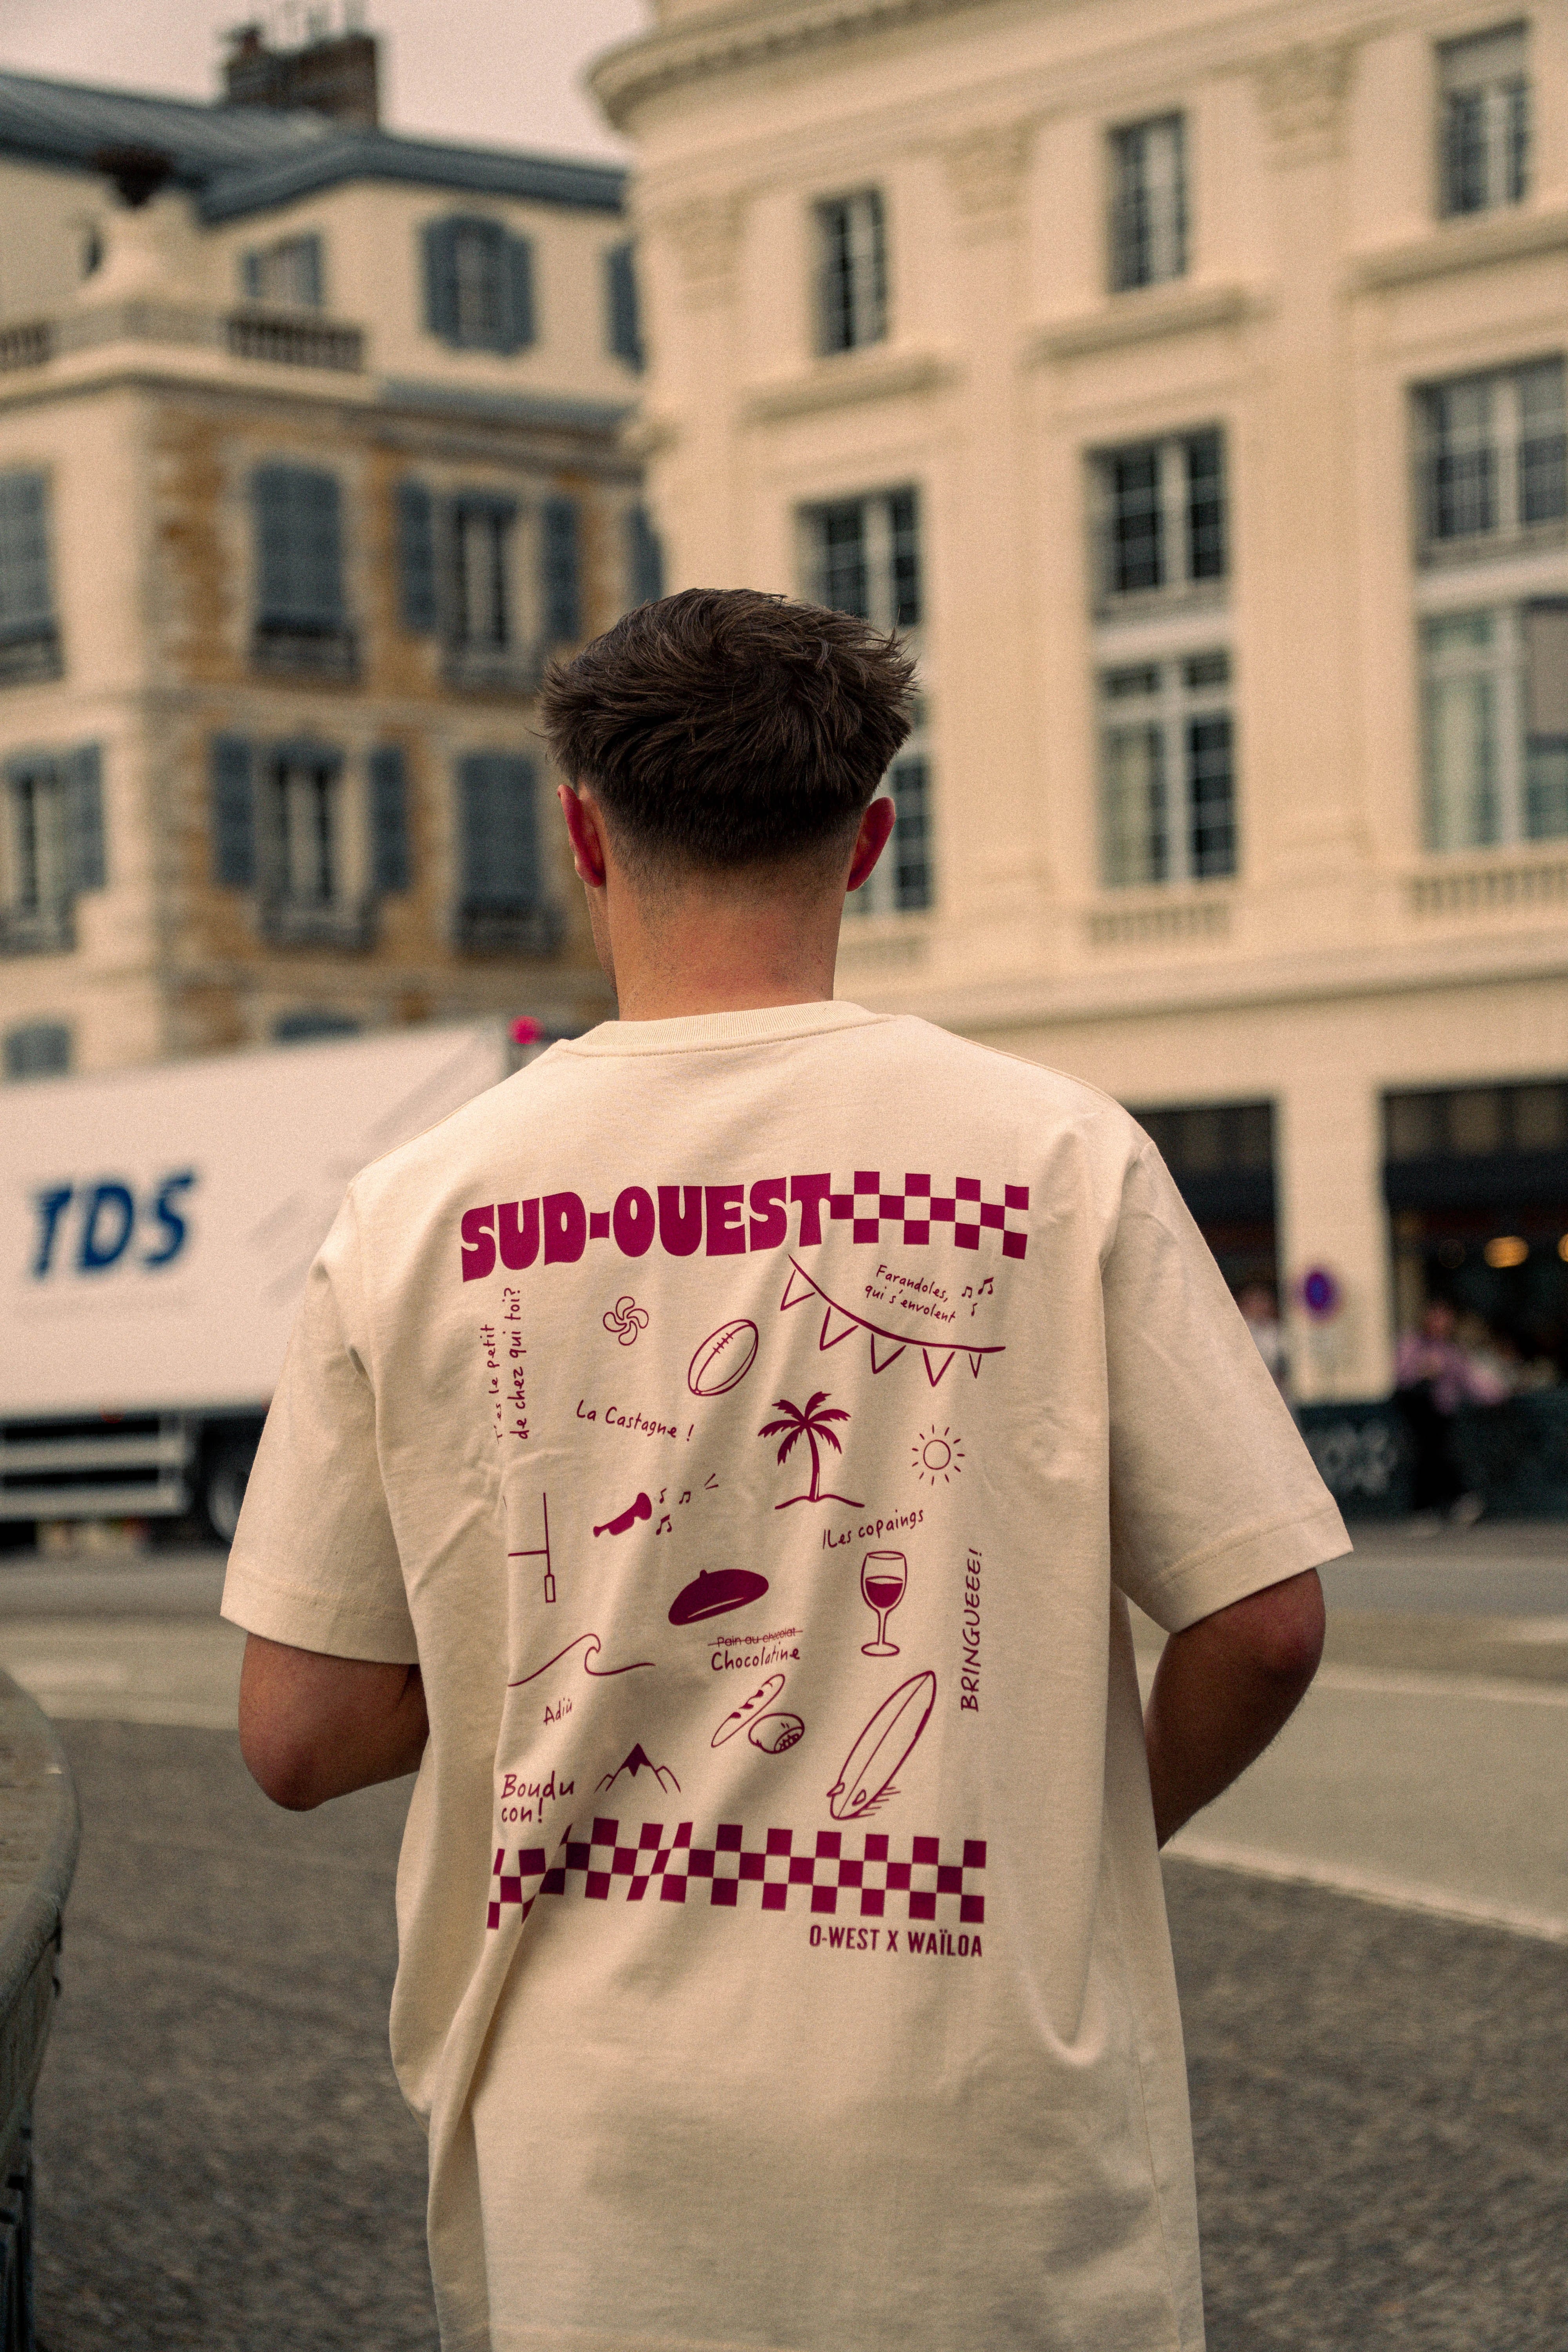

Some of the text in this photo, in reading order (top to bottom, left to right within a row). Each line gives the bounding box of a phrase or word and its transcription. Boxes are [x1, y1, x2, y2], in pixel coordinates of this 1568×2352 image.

[33, 1170, 197, 1277] TDS
[461, 1172, 831, 1283] SUD-OUEST
[876, 1264, 948, 1303] Farandoles,
[865, 1285, 956, 1323] qui s'envolent
[479, 1324, 500, 1368] petit
[502, 1287, 530, 1439] de chez qui toi?
[488, 1377, 499, 1394] le
[576, 1399, 597, 1421] La
[605, 1406, 677, 1438] Castagne
[858, 1509, 924, 1539] copaings
[960, 1548, 982, 1712] BRINGUEEE!
[711, 1641, 800, 1671] Chocolatine
[501, 1770, 575, 1800] Boudu
[501, 1797, 543, 1823] con!
[809, 1924, 982, 1957] O-WEST X WAÏLOA
